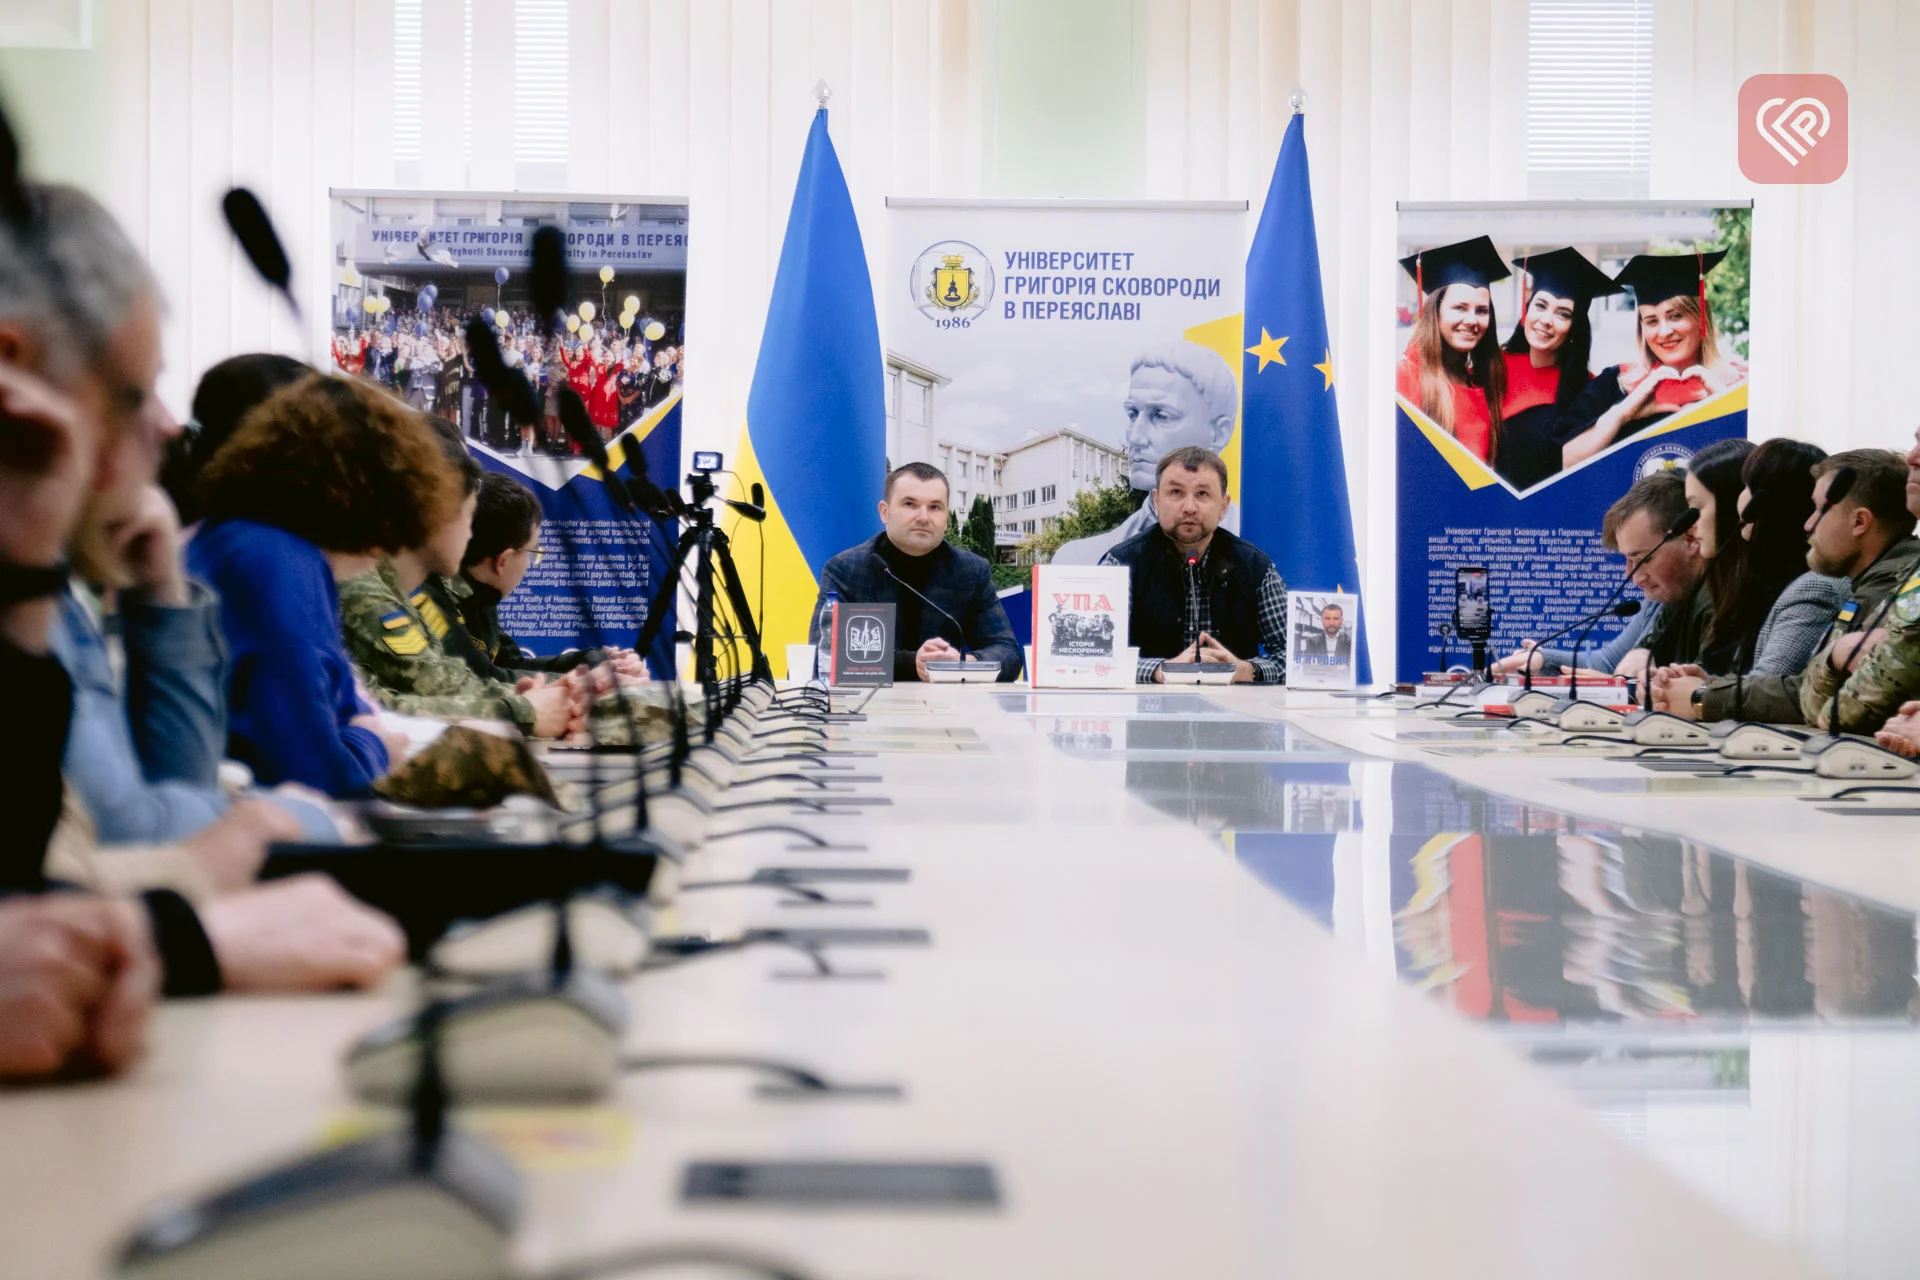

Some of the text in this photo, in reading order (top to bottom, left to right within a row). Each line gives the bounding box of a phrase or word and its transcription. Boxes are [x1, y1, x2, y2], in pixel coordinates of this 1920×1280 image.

[372, 230, 460, 244] УНІВЕРИТЕТ
[464, 232, 523, 244] ГРИГОРІЯ
[622, 234, 630, 246] В
[486, 248, 531, 257] Skovorod
[601, 250, 653, 259] Pereiaslav
[1004, 252, 1134, 271] УНІВЕРСИТЕТ
[1004, 276, 1220, 300] ГРИГОРІЯ СКОВОРОДИ
[1004, 301, 1140, 320] В ПЕРЕЯСЛАВІ
[936, 316, 970, 330] 1986
[1444, 528, 1482, 536] Університет
[1484, 527, 1511, 537] Григорія
[1514, 528, 1549, 537] Сковороди
[1558, 528, 1594, 537] Переяславі
[1453, 536, 1474, 544] освіти,
[1539, 538, 1571, 546] базується
[1428, 545, 1458, 553] розвитку
[1485, 545, 1537, 554] Переяславщини
[1555, 563, 1592, 571] акредитації
[1563, 581, 1588, 589] рахунок
[520, 596, 542, 604] Faculty
[1052, 593, 1114, 611] УПА
[518, 613, 540, 621] Faculty
[540, 622, 562, 630] Faculty
